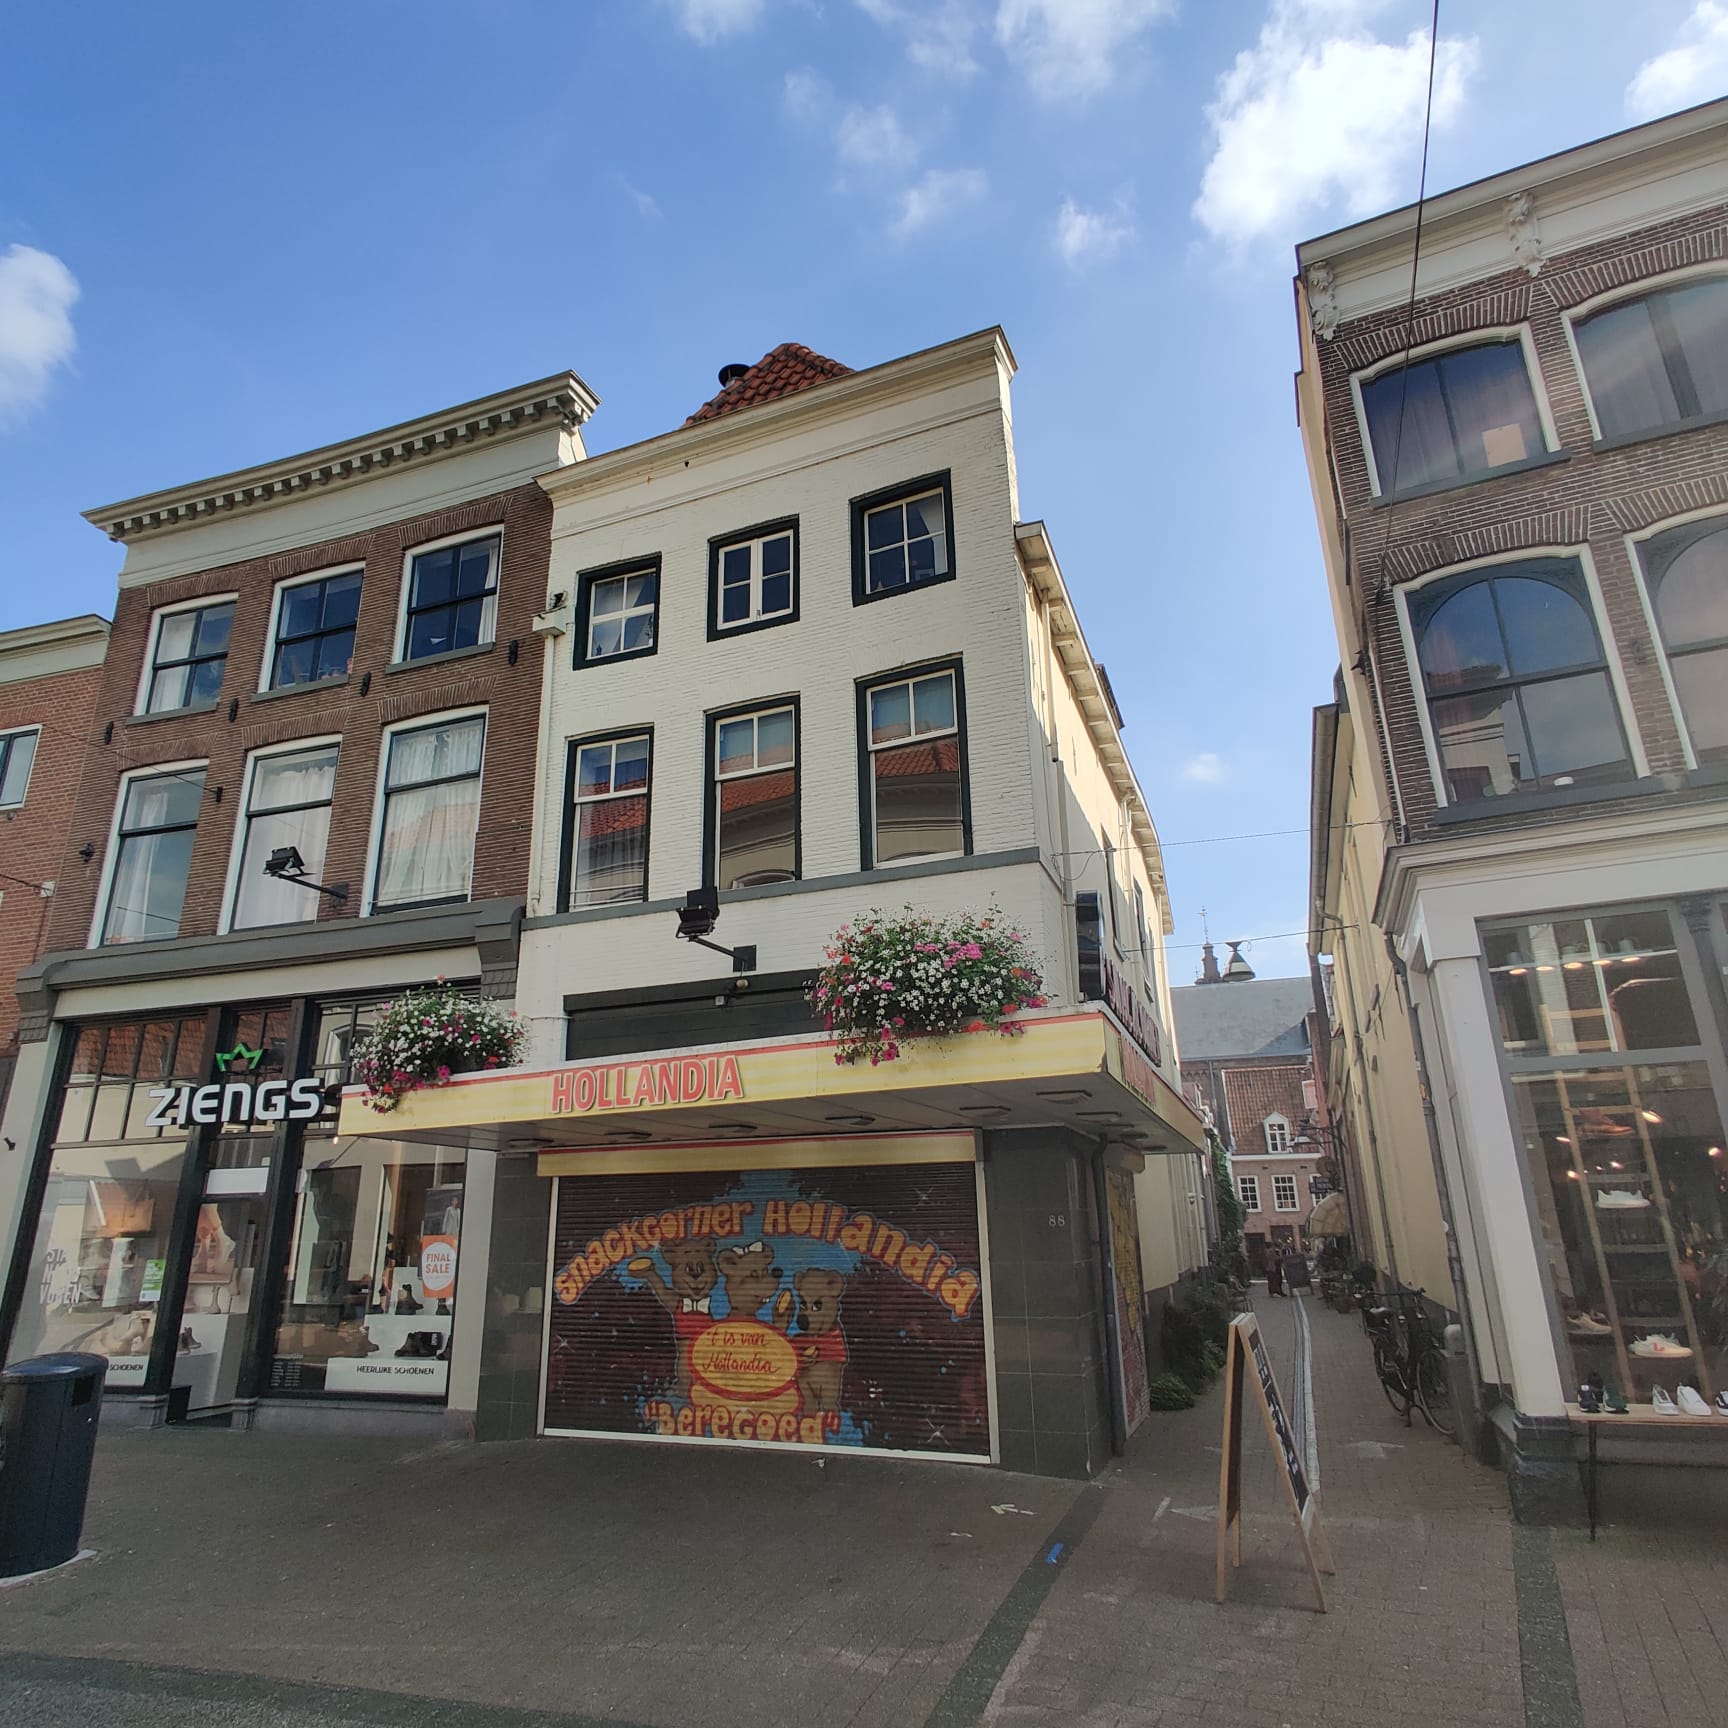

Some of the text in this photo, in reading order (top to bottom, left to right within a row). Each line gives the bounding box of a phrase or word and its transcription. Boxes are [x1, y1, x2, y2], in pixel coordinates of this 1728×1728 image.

[550, 1054, 744, 1114] HOLLANDIA
[145, 1077, 321, 1127] ZIENGS
[1048, 1214, 1065, 1228] 88
[426, 1252, 451, 1262] FINAL
[762, 1199, 981, 1318] Hollandia
[426, 1263, 450, 1274] SALE
[723, 1328, 736, 1346] is
[740, 1331, 769, 1347] van
[394, 1366, 435, 1375] SCHOENEN
[702, 1350, 780, 1375] Hollandia
